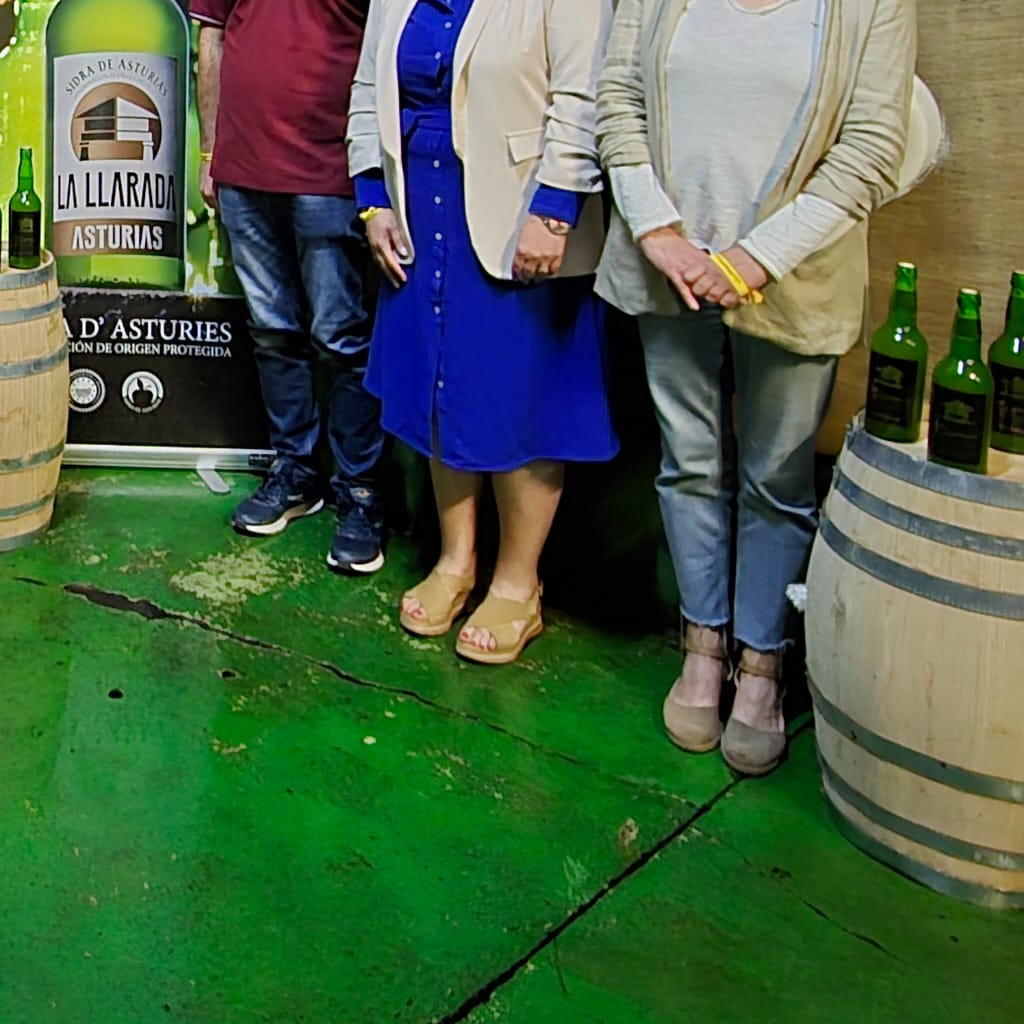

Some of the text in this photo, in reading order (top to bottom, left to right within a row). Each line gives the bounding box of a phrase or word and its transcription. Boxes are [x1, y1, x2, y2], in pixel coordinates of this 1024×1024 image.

[65, 58, 169, 97] SIDRA DE ASTURIAS
[57, 171, 176, 212] LA LLARADA
[71, 224, 164, 251] ASTURIAS
[110, 317, 233, 344] ASTURIES
[96, 342, 113, 354] DE
[114, 342, 161, 355] ORIGEN
[163, 343, 233, 358] PROTEGIDA
